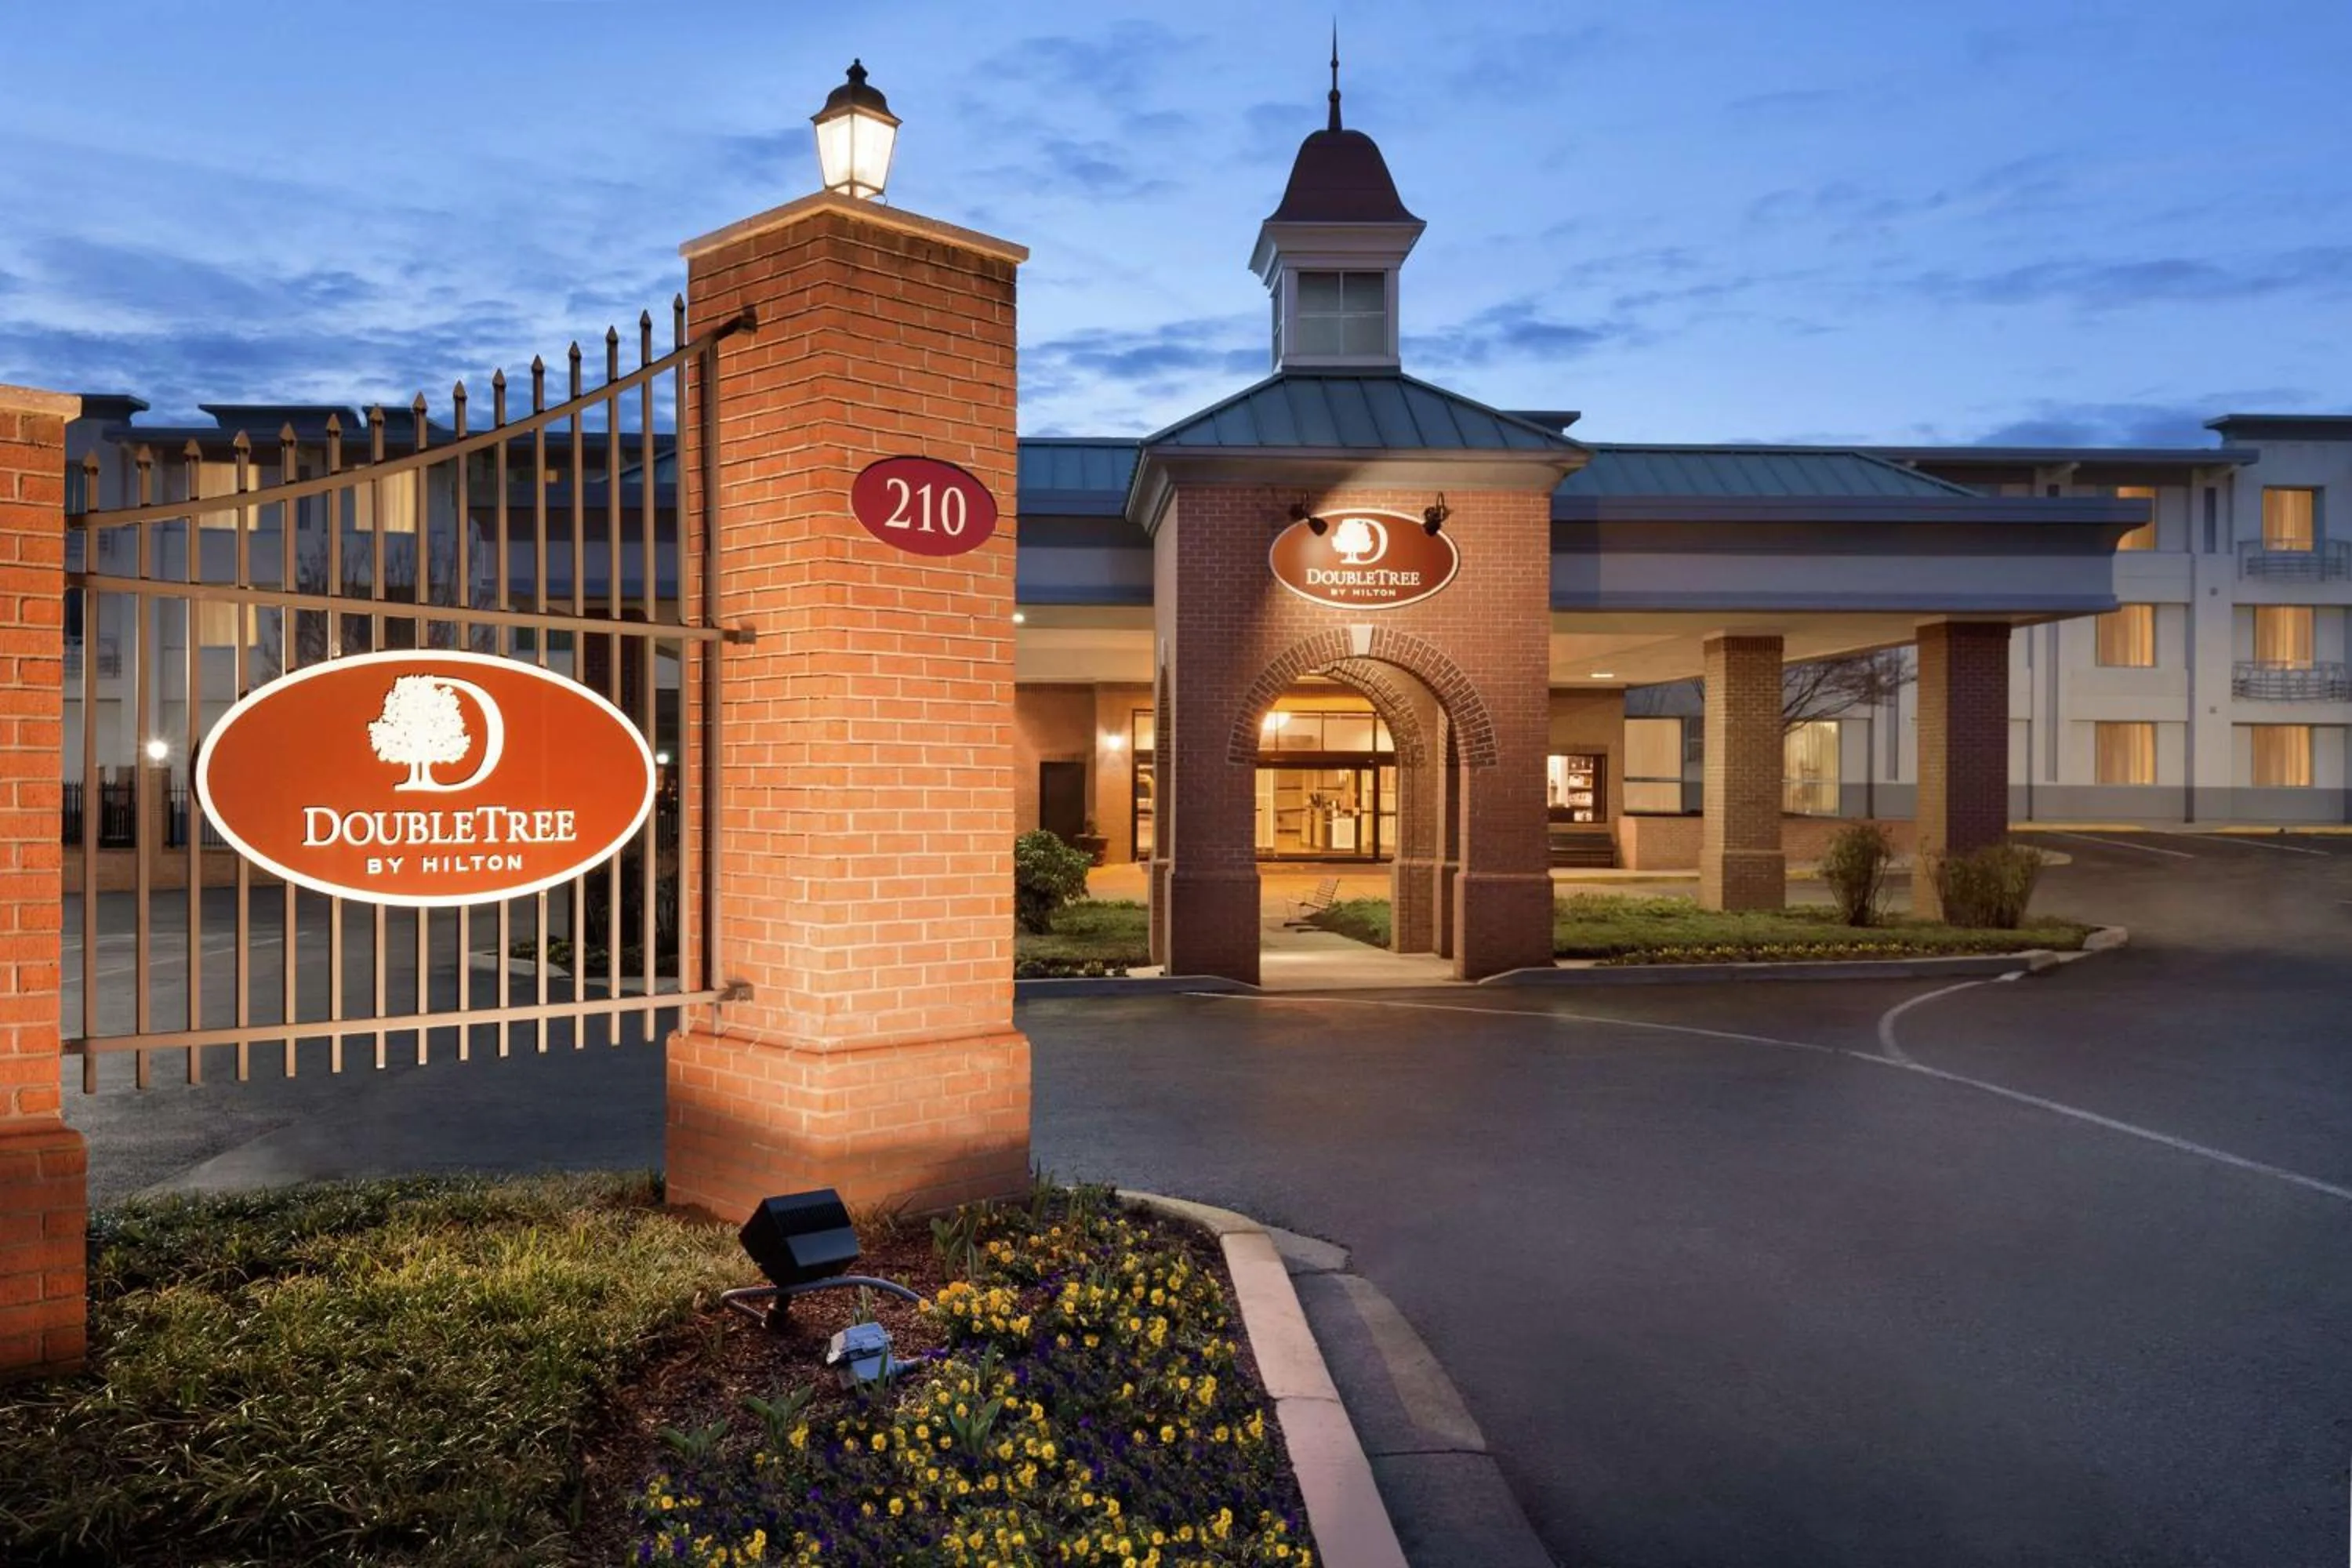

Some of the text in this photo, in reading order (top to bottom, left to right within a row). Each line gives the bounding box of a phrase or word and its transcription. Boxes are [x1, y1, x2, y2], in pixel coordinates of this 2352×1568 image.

[884, 477, 967, 536] 210
[367, 855, 523, 875] BY HILTON
